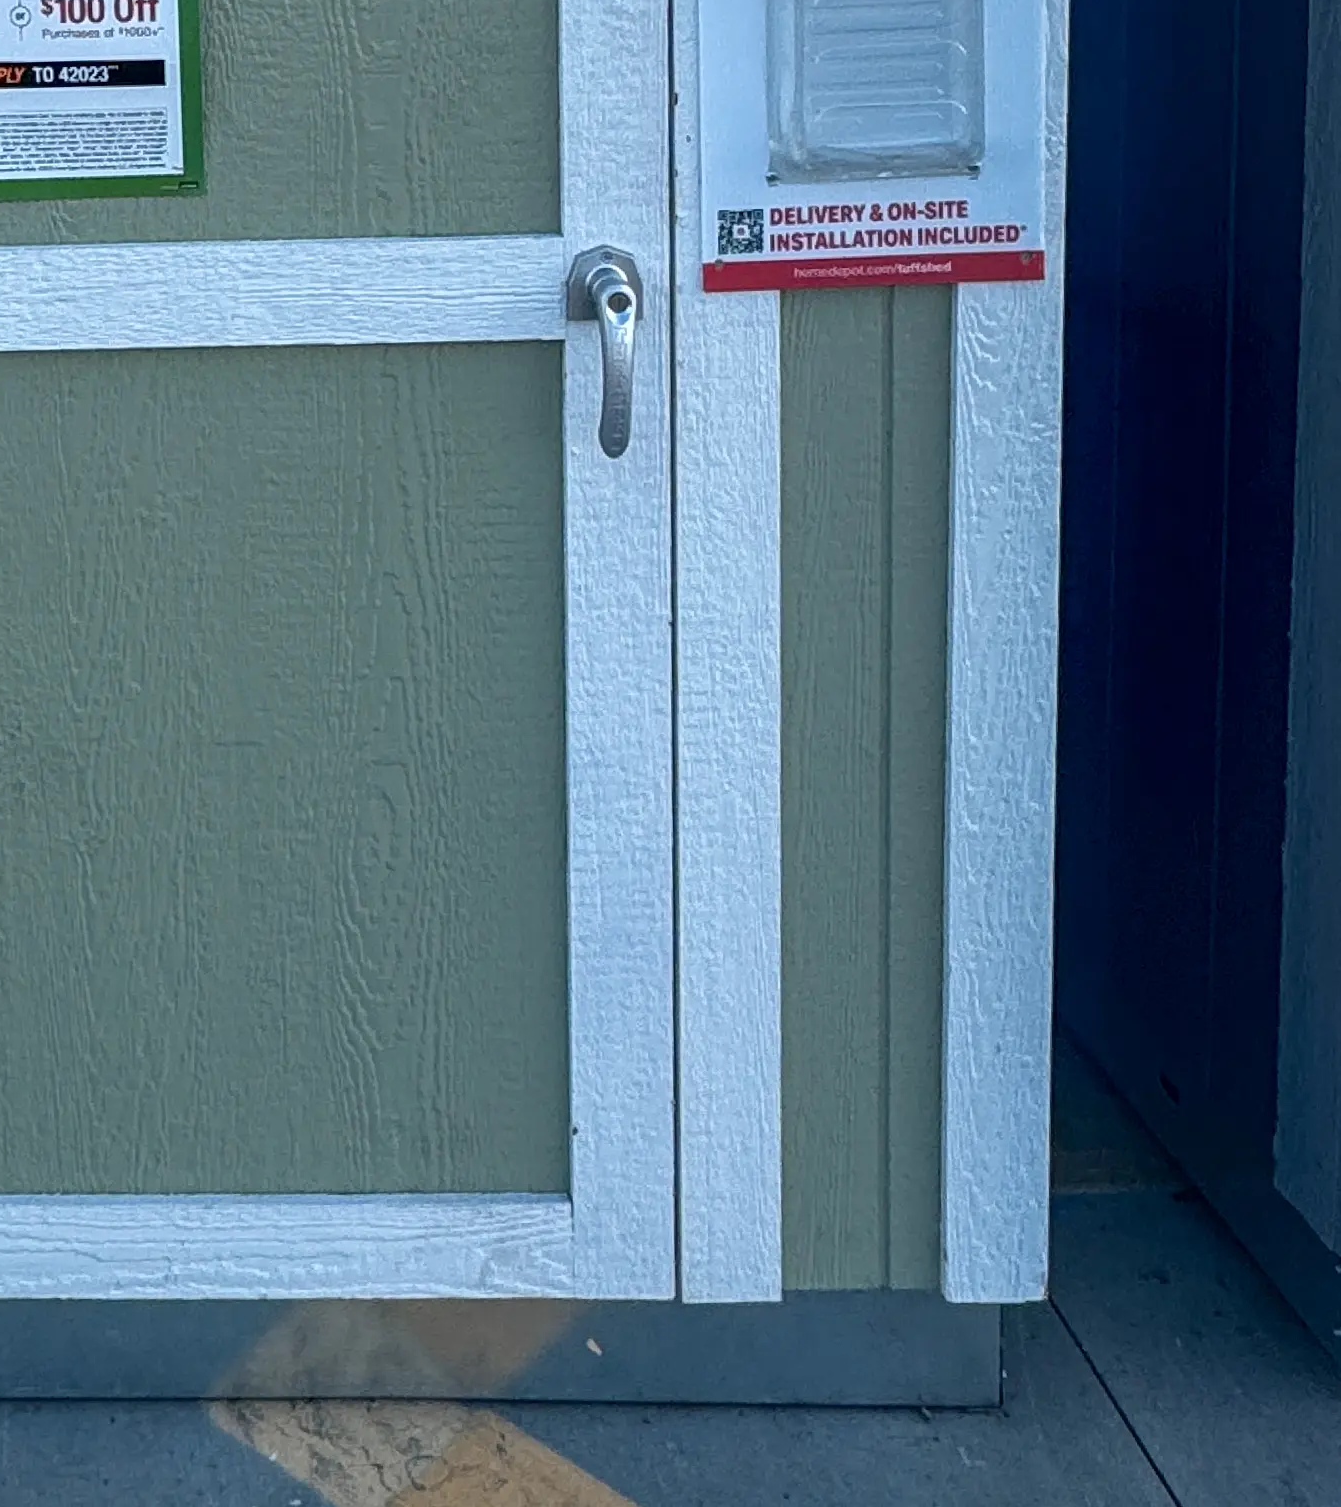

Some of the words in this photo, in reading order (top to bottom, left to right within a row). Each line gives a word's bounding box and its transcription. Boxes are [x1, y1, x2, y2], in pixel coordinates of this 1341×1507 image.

[32, 67, 54, 83] TO
[770, 204, 866, 227] DELIVERY
[869, 203, 883, 222] &
[887, 200, 969, 221] ON-SITE
[770, 228, 910, 253] INSTALLATION
[794, 261, 952, 279] homedepot.com/tuffshed
